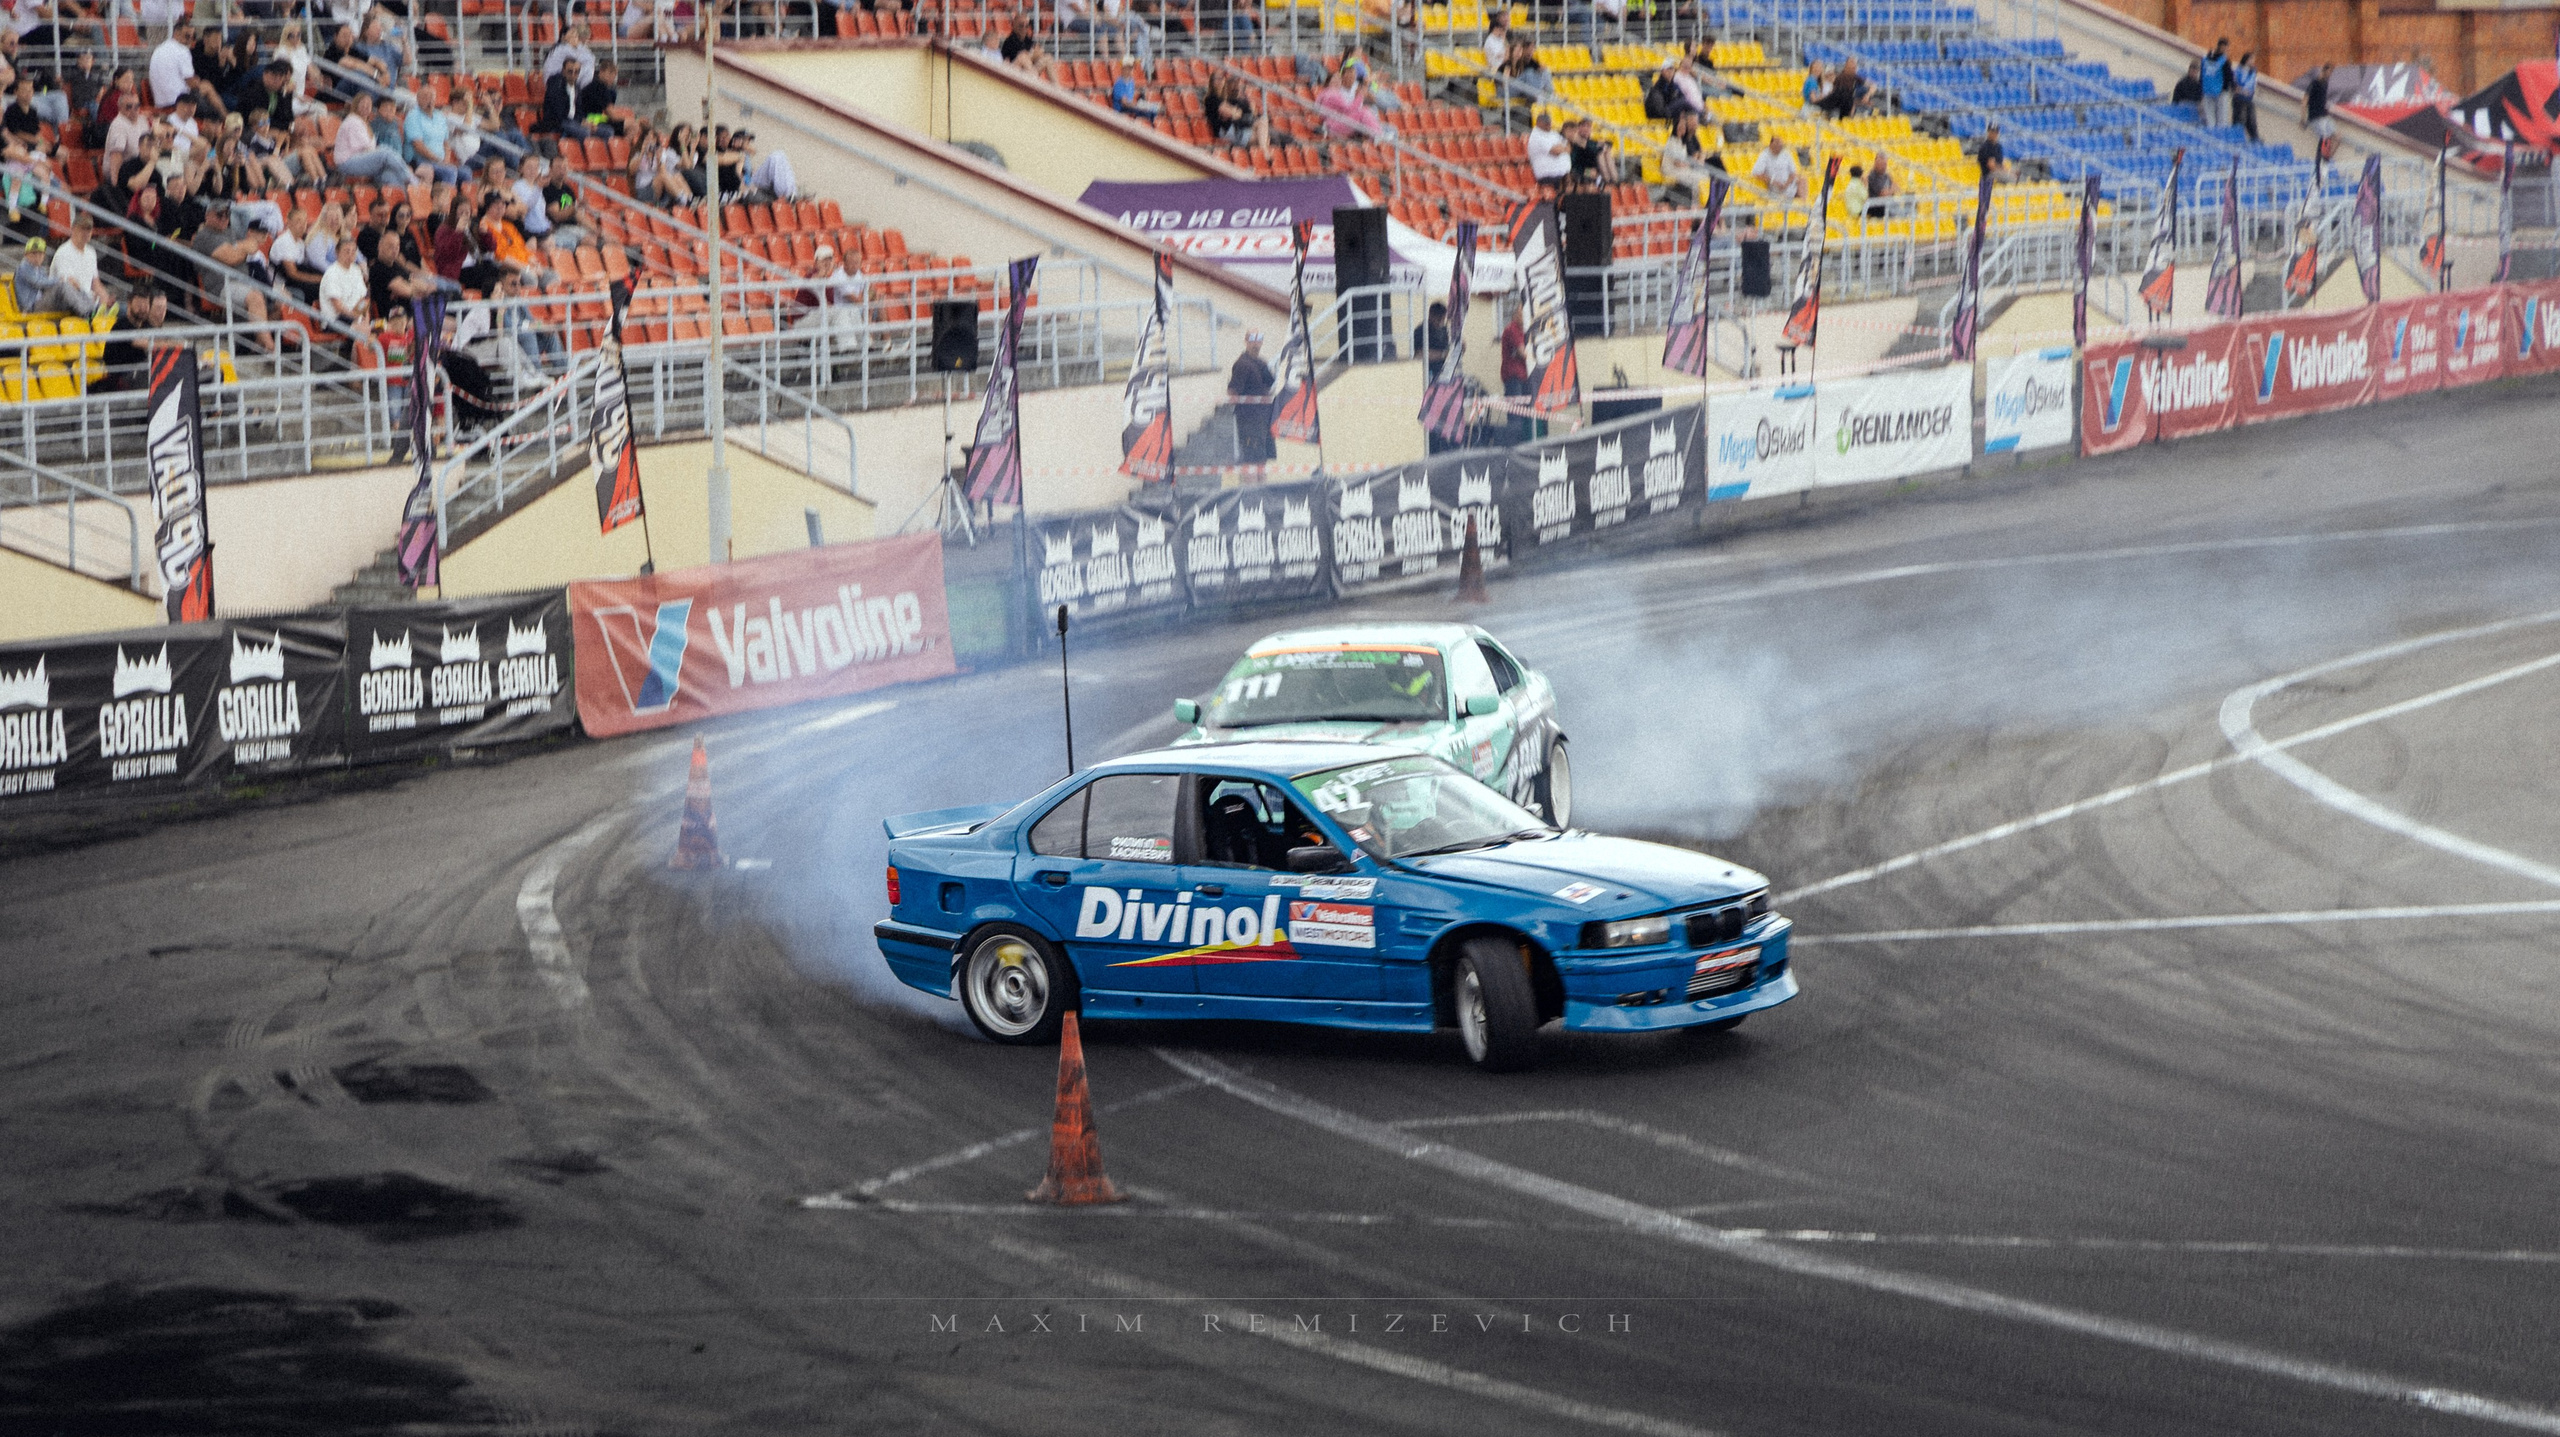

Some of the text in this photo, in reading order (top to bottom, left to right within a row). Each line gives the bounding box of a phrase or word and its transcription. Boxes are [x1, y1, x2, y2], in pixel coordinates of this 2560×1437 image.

[1118, 206, 1293, 230] АВТО ИЗ США
[2289, 331, 2370, 391] Valvoline
[1451, 504, 1502, 551] GOILLA
[706, 582, 923, 689] Valvoline
[360, 667, 423, 716] GORILLA
[431, 660, 492, 708] GORILLA
[498, 653, 559, 700] GORILLA
[100, 693, 188, 758] GORILLA
[218, 680, 300, 742] GORILLA
[1076, 886, 1281, 946] Divinol
